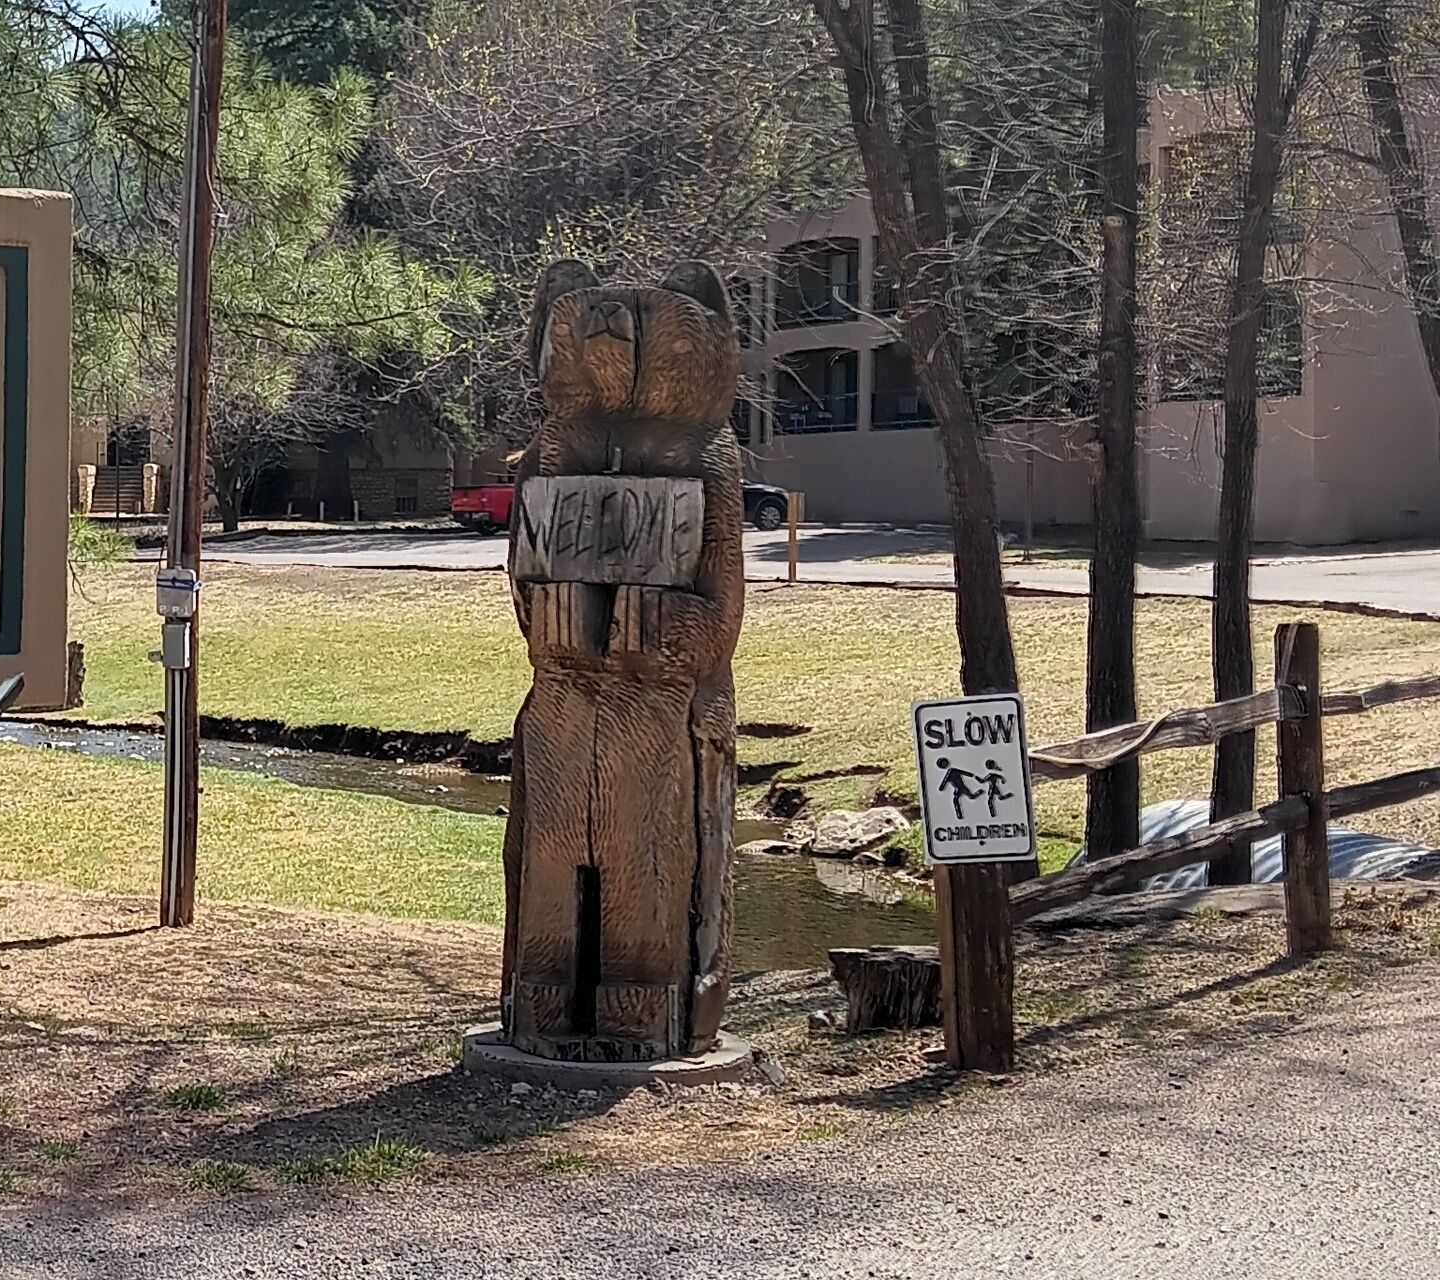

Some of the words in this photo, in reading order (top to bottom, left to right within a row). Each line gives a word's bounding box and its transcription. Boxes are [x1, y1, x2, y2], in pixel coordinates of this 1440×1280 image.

[519, 488, 690, 564] WELCOME
[924, 713, 1014, 750] SLOW
[934, 822, 1028, 842] CHILDREN
